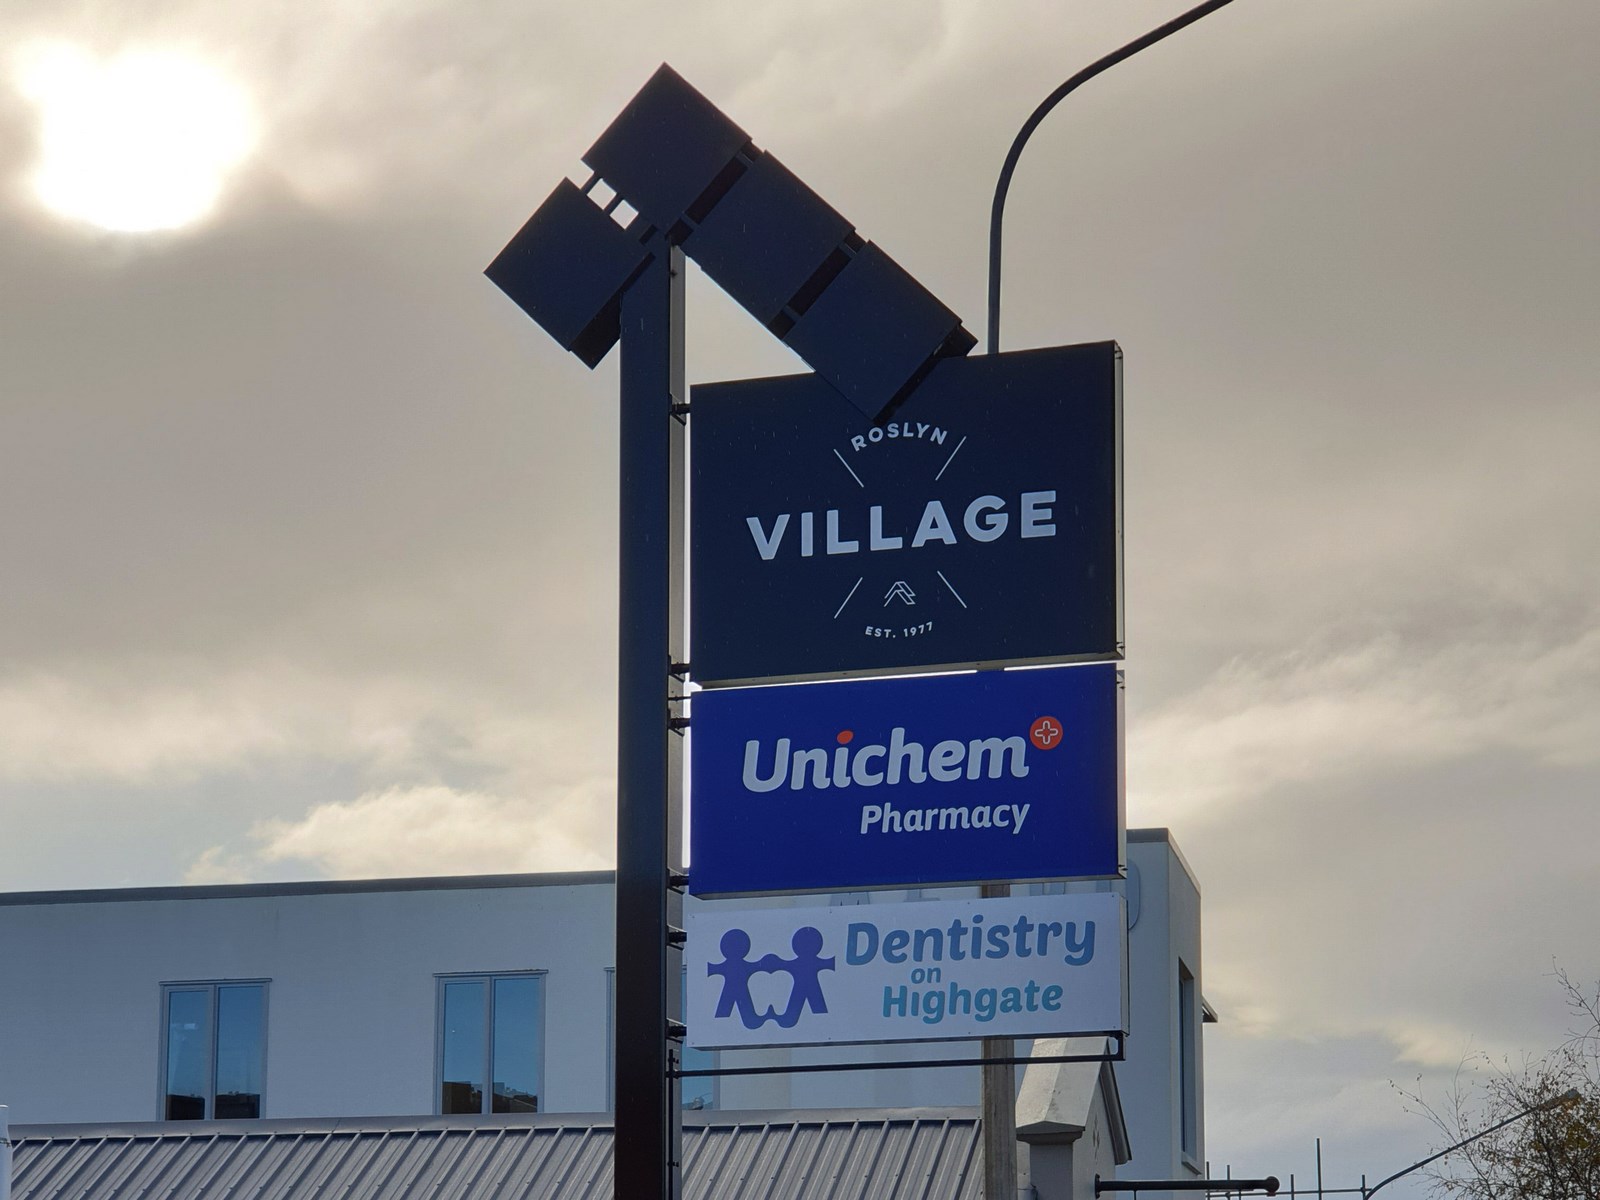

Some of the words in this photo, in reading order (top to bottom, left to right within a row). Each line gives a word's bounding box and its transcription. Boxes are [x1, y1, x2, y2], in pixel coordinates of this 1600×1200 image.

[850, 421, 949, 451] ROSLYN
[746, 490, 1056, 560] VILLAGE
[864, 625, 897, 639] EST.
[903, 620, 934, 638] 1977
[742, 727, 1028, 792] Unichem
[860, 802, 1030, 834] Pharmacy
[846, 914, 1095, 966] Dentistry
[910, 964, 940, 983] on
[882, 979, 1062, 1023] Highgate
